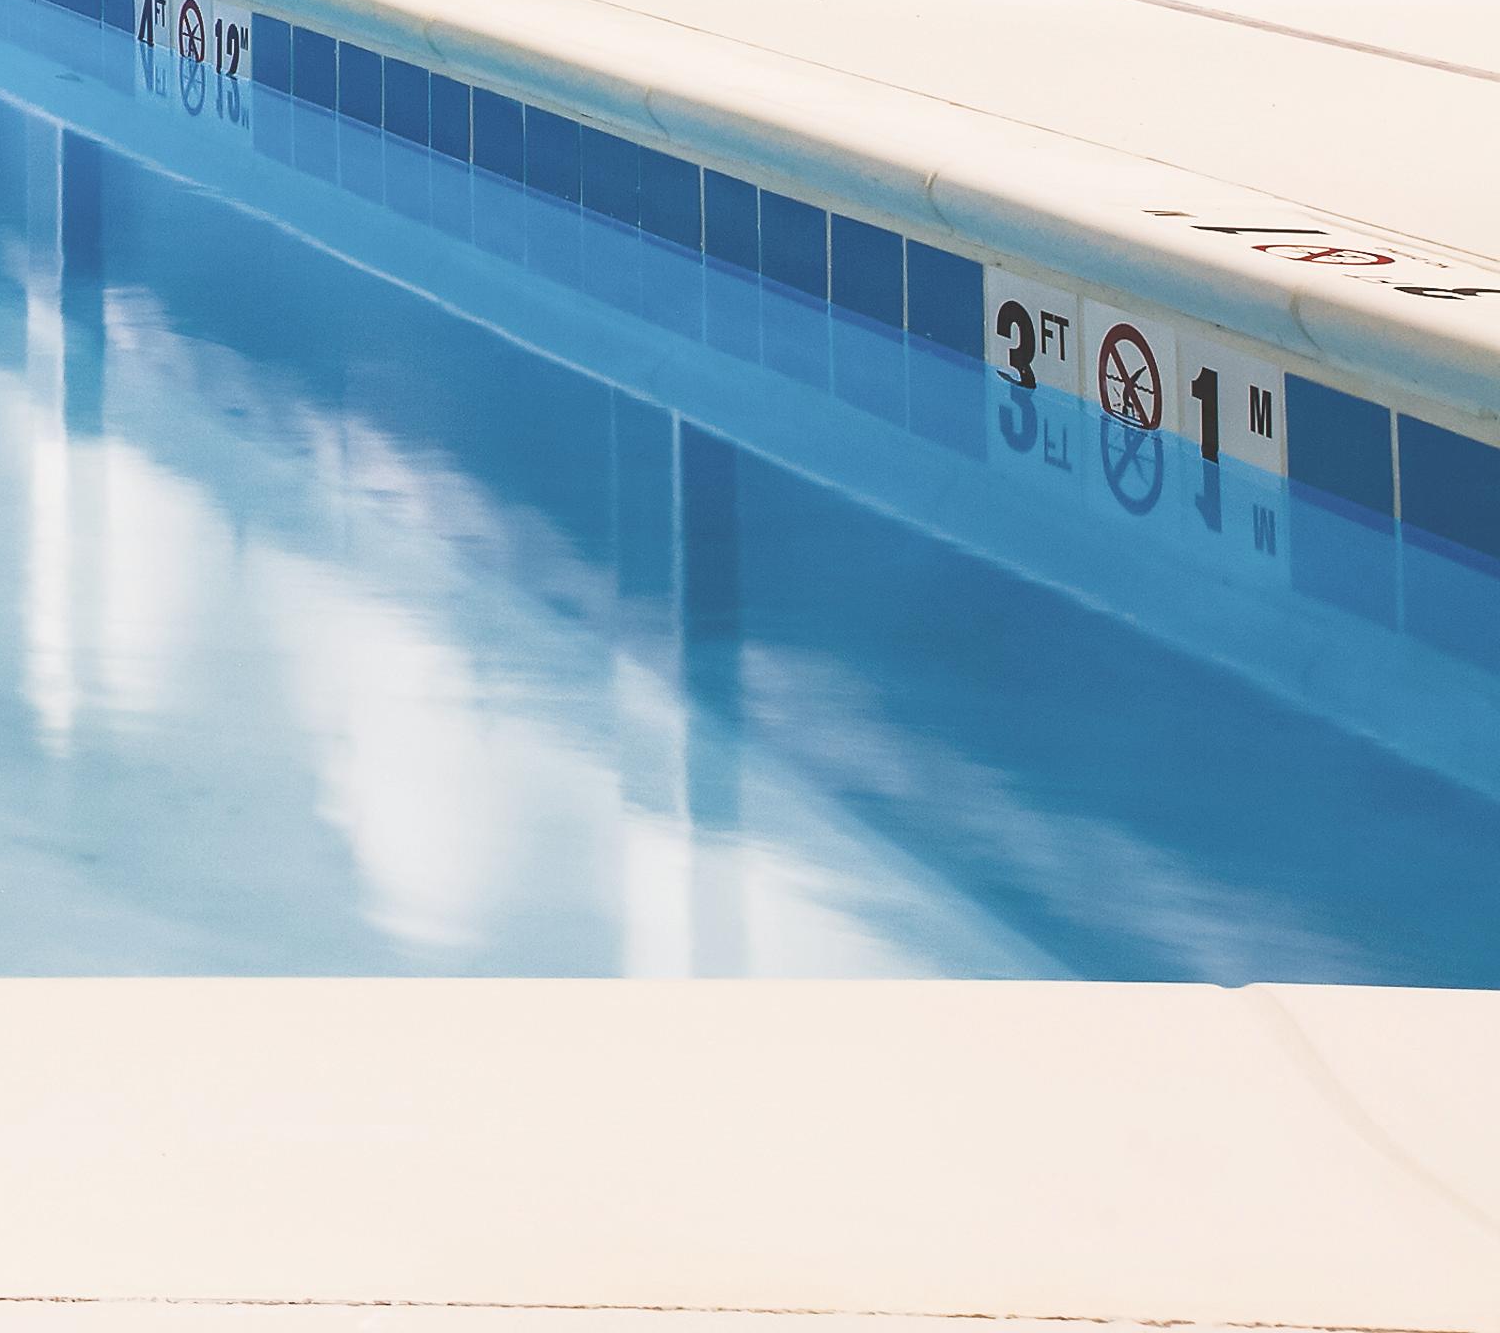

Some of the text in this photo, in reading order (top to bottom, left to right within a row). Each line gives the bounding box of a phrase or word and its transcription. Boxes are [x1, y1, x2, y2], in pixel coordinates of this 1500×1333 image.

[996, 299, 1070, 389] 3 FT
[1191, 366, 1273, 465] 1 M
